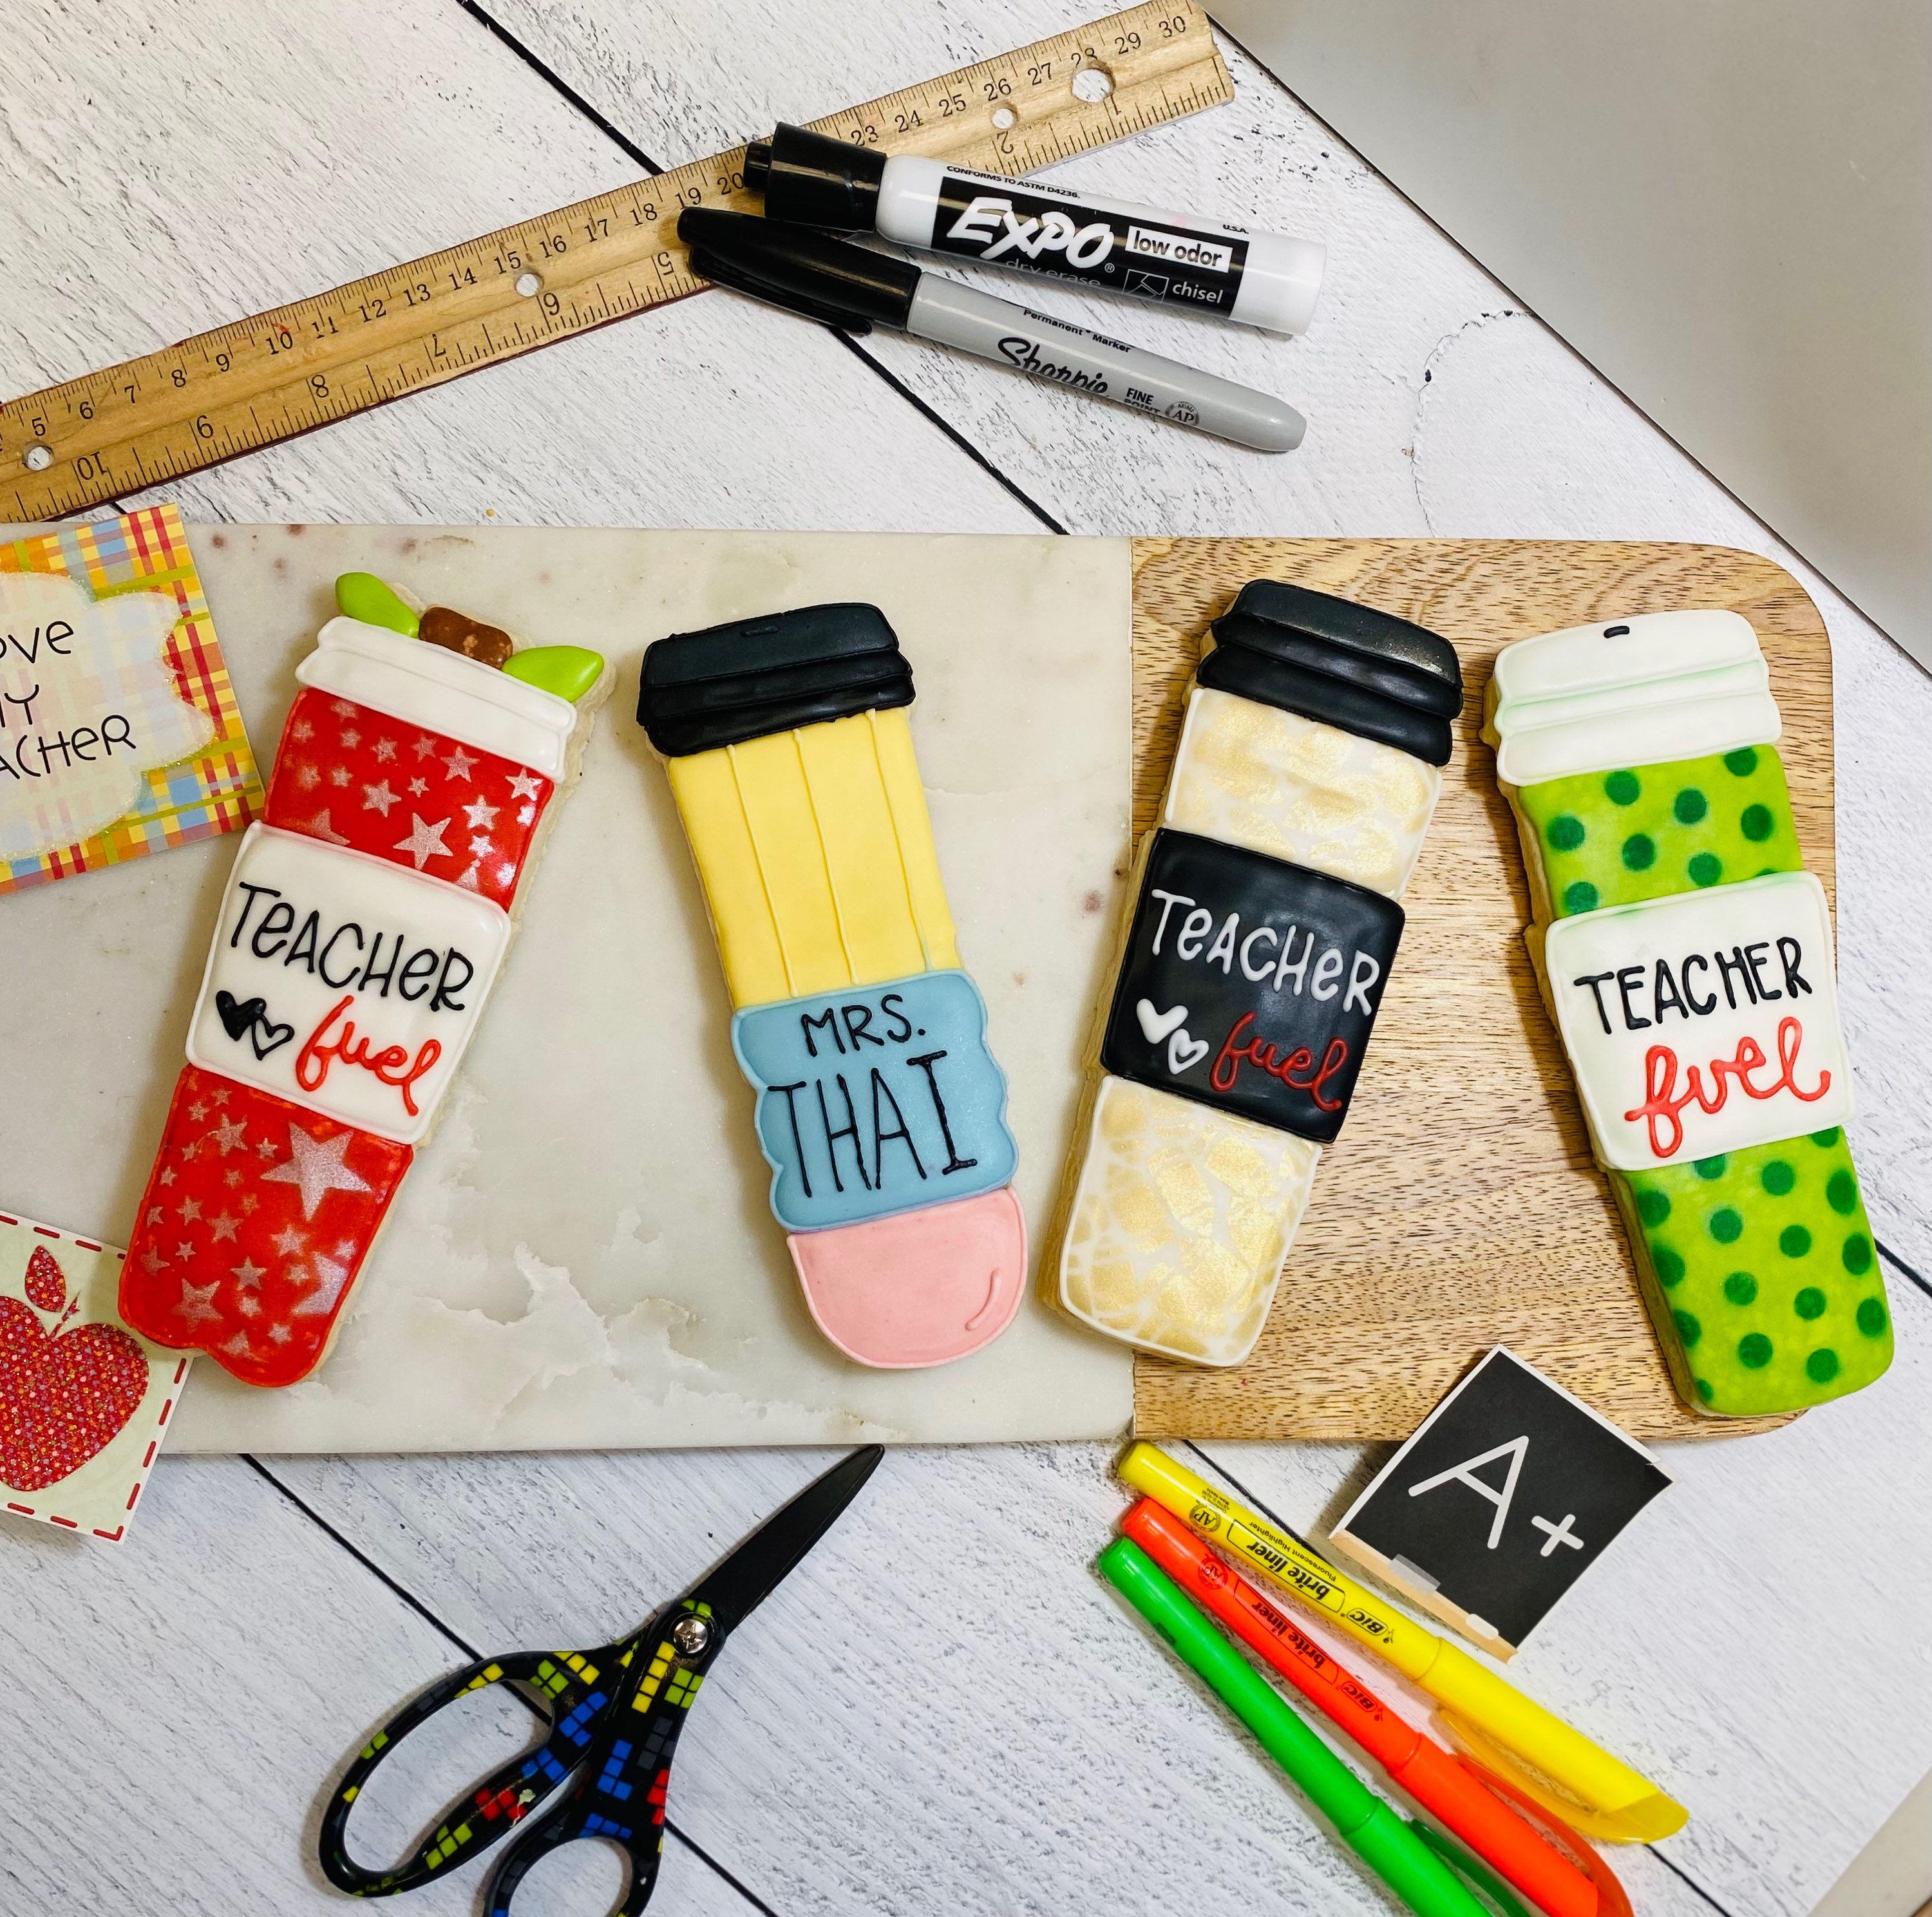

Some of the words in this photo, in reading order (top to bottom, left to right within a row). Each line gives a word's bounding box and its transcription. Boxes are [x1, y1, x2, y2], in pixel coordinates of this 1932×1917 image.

[1110, 93, 1121, 115] 1
[996, 130, 1014, 154] 2
[947, 165, 1002, 183] CONFORMS
[1017, 180, 1045, 191] ASTM
[32, 417, 46, 436] 5
[80, 401, 93, 420] 6
[124, 384, 137, 404] 7
[171, 369, 186, 388] 8
[216, 354, 230, 372] 9
[265, 332, 294, 355] 10
[311, 316, 339, 339] 11
[358, 299, 386, 322] 12
[403, 283, 431, 307] 13
[449, 267, 477, 291] 14
[494, 250, 521, 275] 15
[539, 235, 567, 258] 16
[584, 218, 609, 243] 17
[629, 202, 658, 227] 18
[674, 187, 701, 209] 19
[717, 171, 744, 196] 20
[851, 125, 878, 146] 23
[894, 109, 923, 133] 24
[938, 94, 967, 117] 25
[983, 78, 1012, 101] 26
[1027, 62, 1054, 86] 27
[1114, 32, 1142, 55] 29
[1158, 15, 1187, 38] 30
[657, 252, 674, 276] 5
[1133, 231, 1170, 256] low
[1174, 244, 1222, 267] odor
[1005, 259, 1041, 273] dry
[1048, 270, 1101, 287] erase
[1172, 281, 1224, 304] chisel
[433, 334, 446, 357] 7
[1023, 309, 1083, 336] Permanent
[1092, 334, 1131, 353] Marker
[311, 374, 330, 399] 8
[1126, 388, 1154, 406] FINE
[1173, 410, 1195, 423] AP
[77, 451, 108, 480] 10
[0, 685, 39, 728] Y
[1573, 936, 1812, 1034] TEACHER
[801, 994, 926, 1057] MRS.
[296, 995, 442, 1116] fuel
[1209, 1010, 1349, 1112] fuel
[1624, 1016, 1832, 1158] fuel
[767, 1050, 978, 1198] THAI
[1408, 1435, 1584, 1557] A+
[1193, 1510, 1217, 1526] AP
[1249, 1521, 1291, 1553] Highlighter
[1246, 1541, 1287, 1576] liner
[1286, 1546, 1337, 1582] Fluorescent
[1287, 1563, 1331, 1601] brite
[1251, 1601, 1289, 1636] liner
[1349, 1610, 1385, 1634] BIC
[1288, 1633, 1325, 1669] brite
[1343, 1683, 1374, 1710] BIC
